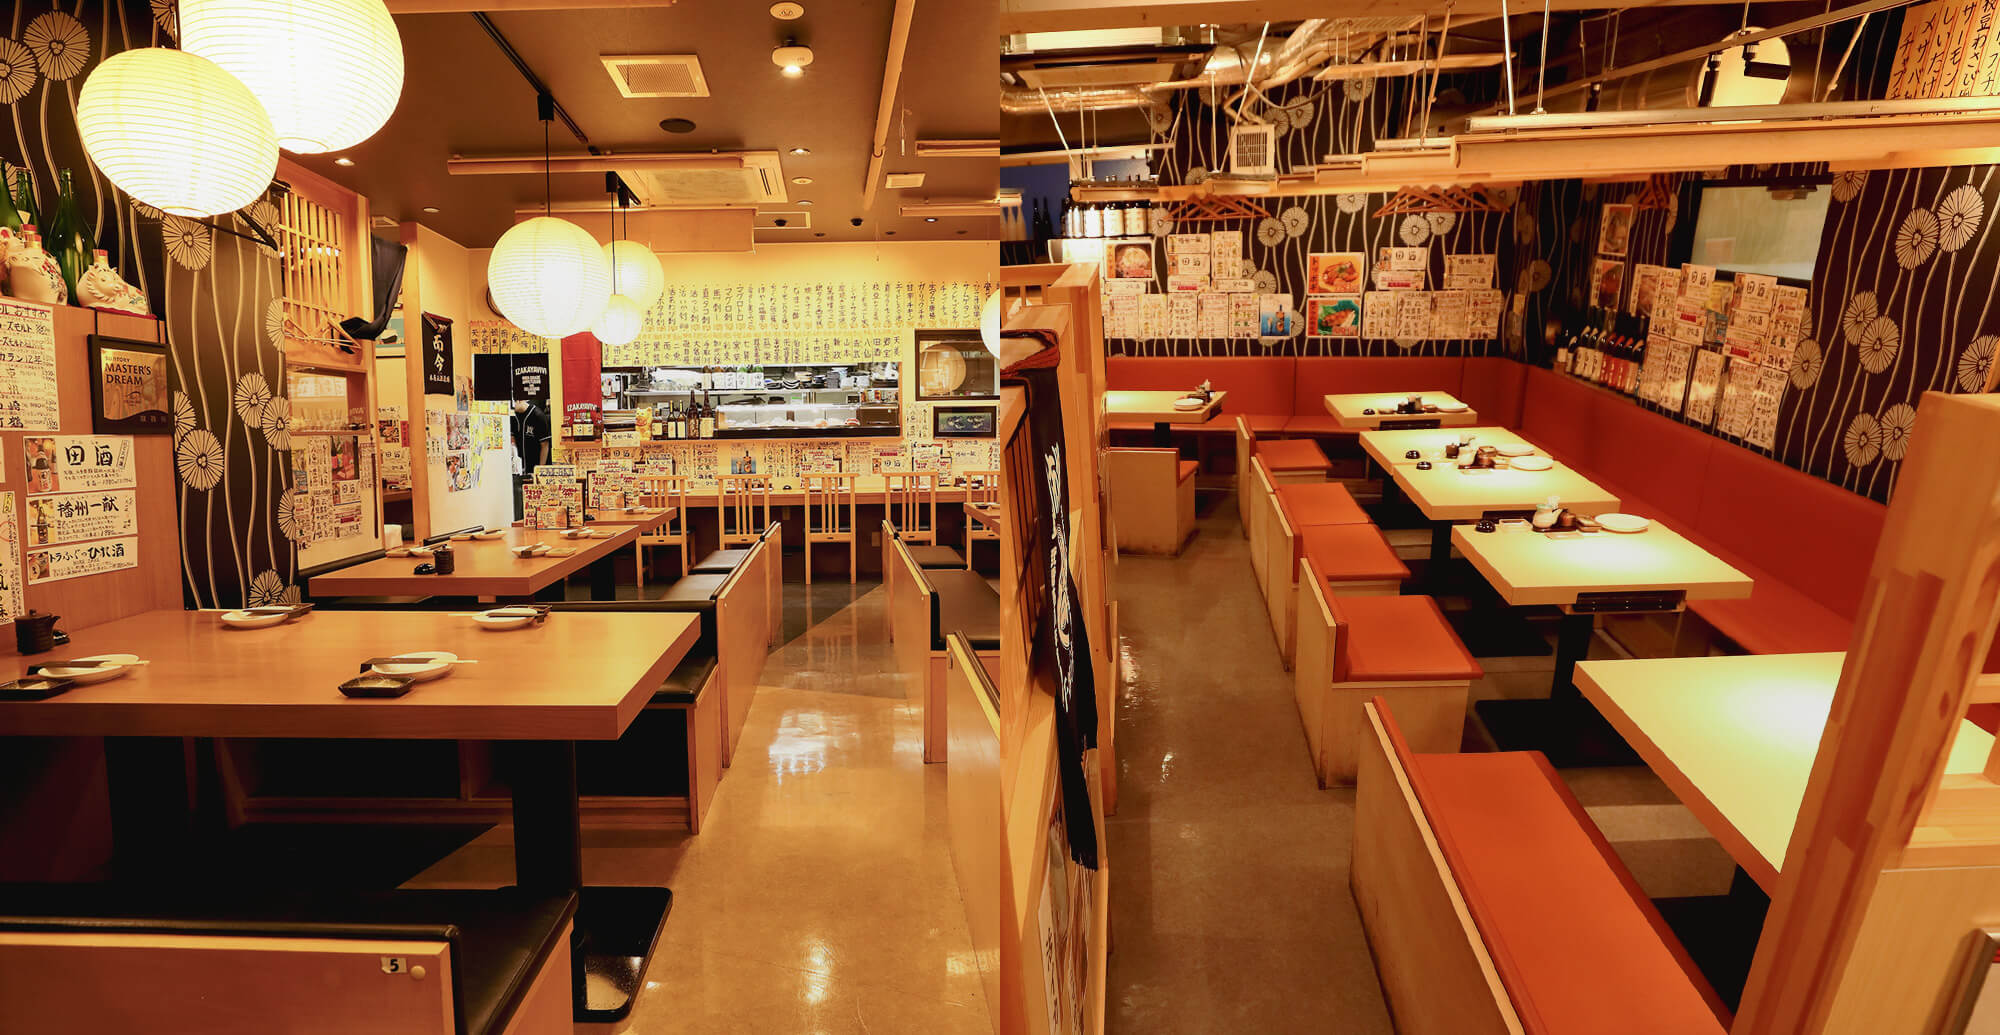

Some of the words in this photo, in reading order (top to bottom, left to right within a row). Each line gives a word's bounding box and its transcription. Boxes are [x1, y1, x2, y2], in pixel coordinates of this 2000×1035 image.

[105, 362, 152, 376] MASTER'S
[106, 374, 143, 385] DREAM
[64, 445, 113, 467] 田酒
[57, 496, 119, 519] 播州一献
[390, 958, 400, 972] 5
